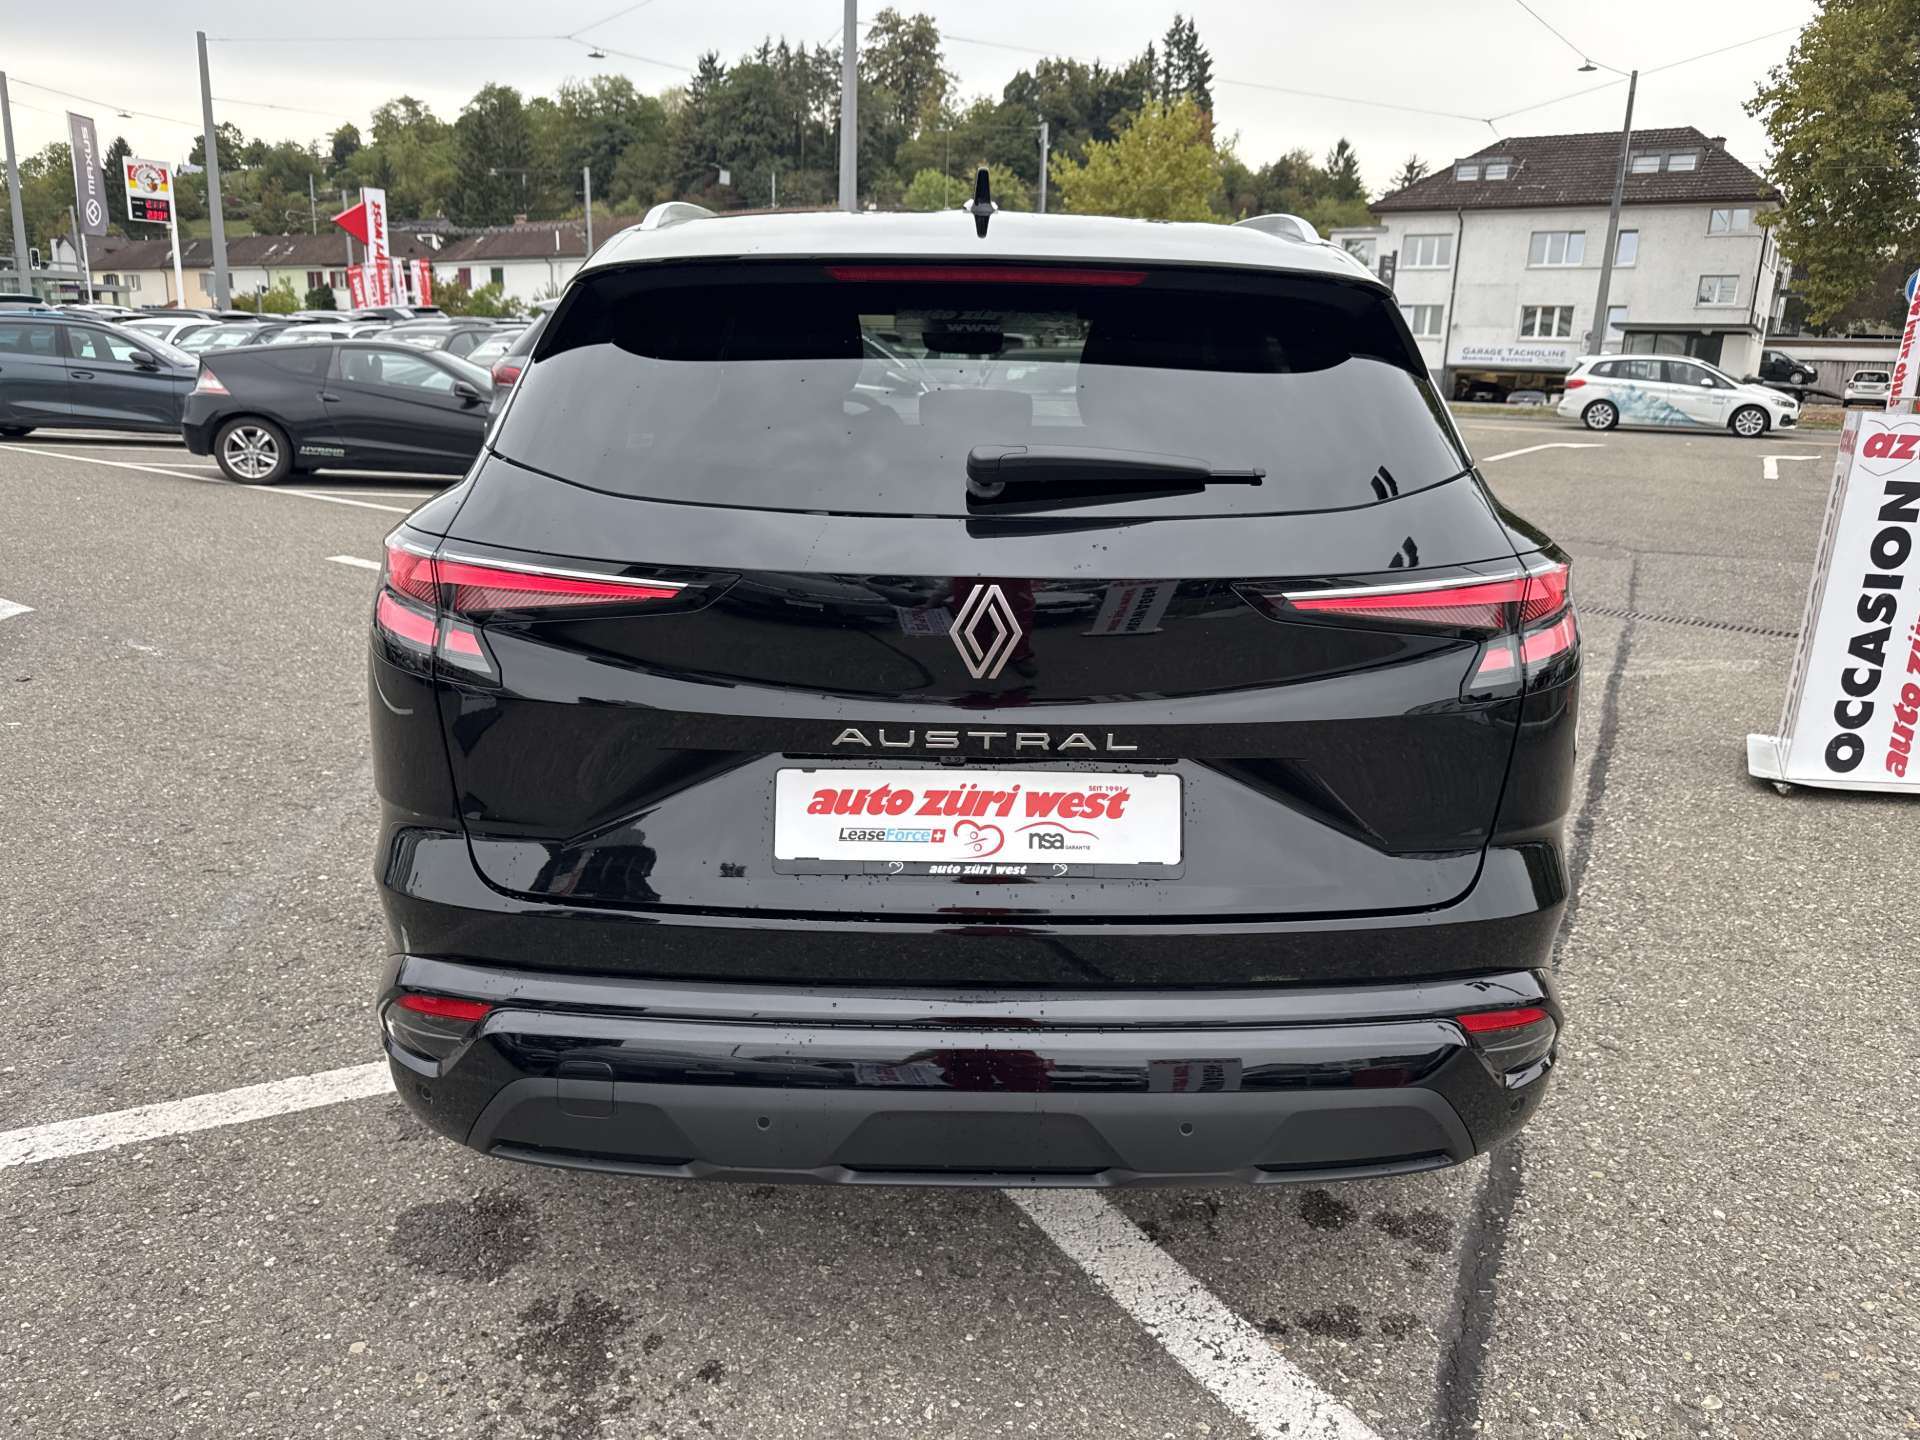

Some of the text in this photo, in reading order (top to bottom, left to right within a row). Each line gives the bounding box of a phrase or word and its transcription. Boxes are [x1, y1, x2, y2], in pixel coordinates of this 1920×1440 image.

[81, 127, 96, 195] MAXUS
[1462, 347, 1503, 356] GARAGE
[1825, 480, 1920, 773] OCCASION
[832, 728, 1138, 750] AUSTRAL
[1886, 682, 1920, 777] auto
[807, 783, 1131, 820] auto züri west
[839, 827, 931, 842] LeaseForce
[1029, 832, 1064, 850] nsa
[929, 864, 1027, 875] auto züri west
